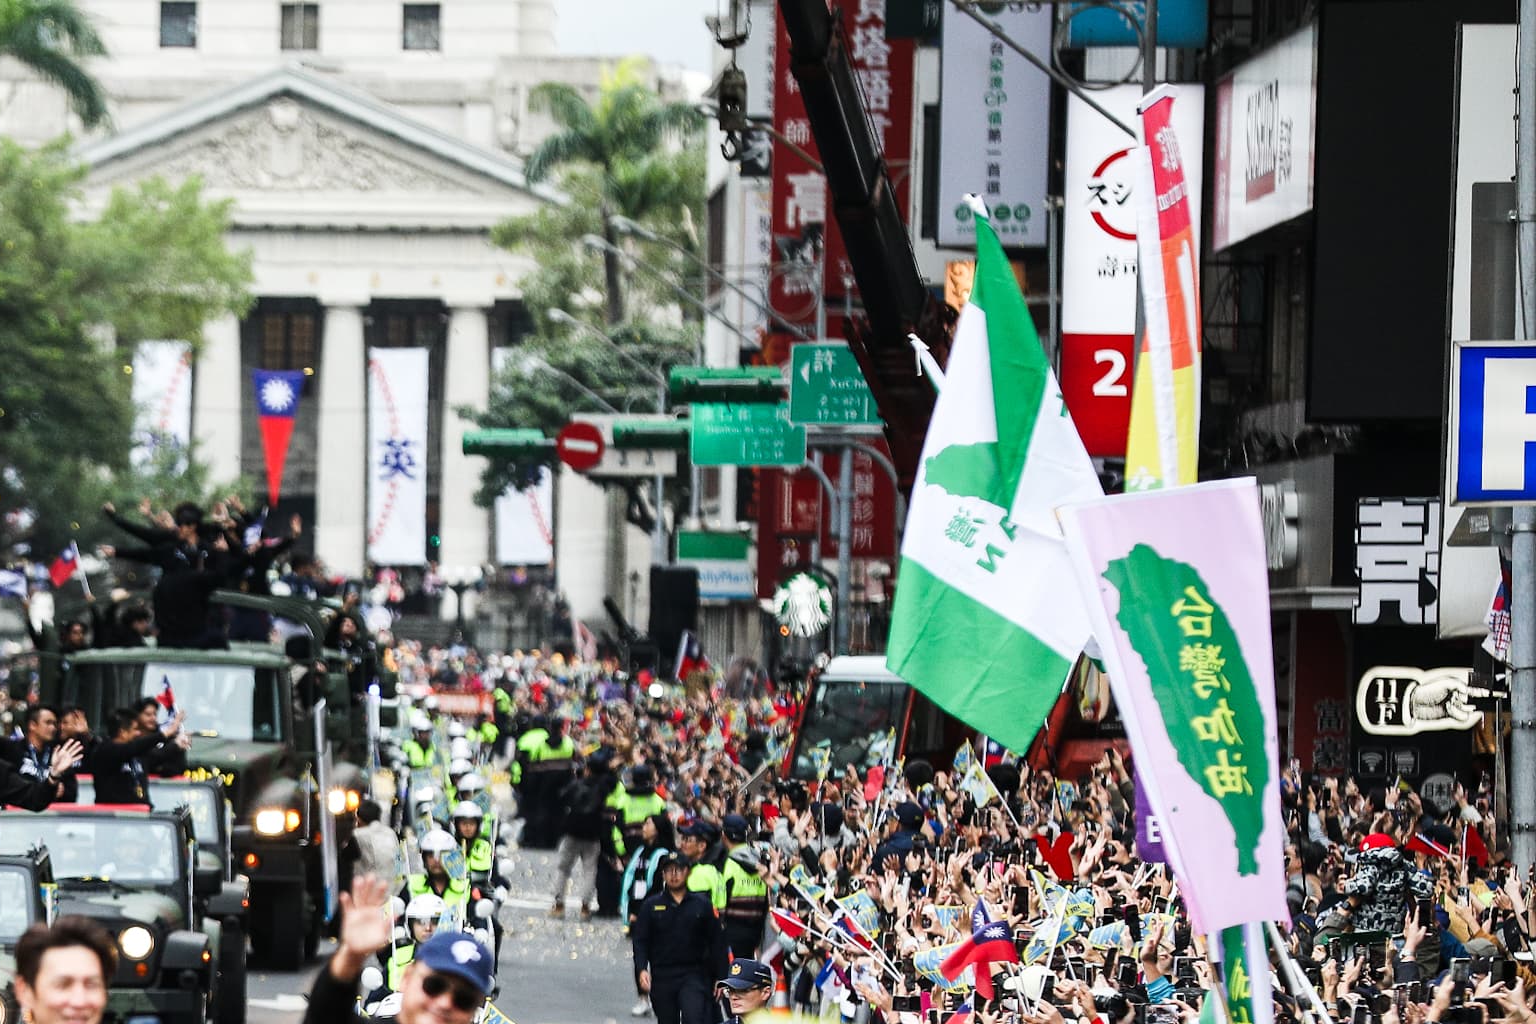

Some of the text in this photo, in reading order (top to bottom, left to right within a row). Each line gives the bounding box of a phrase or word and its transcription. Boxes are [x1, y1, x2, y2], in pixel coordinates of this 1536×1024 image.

[1086, 183, 1132, 206] スシ
[1093, 349, 1127, 396] 2
[379, 438, 417, 481] 英
